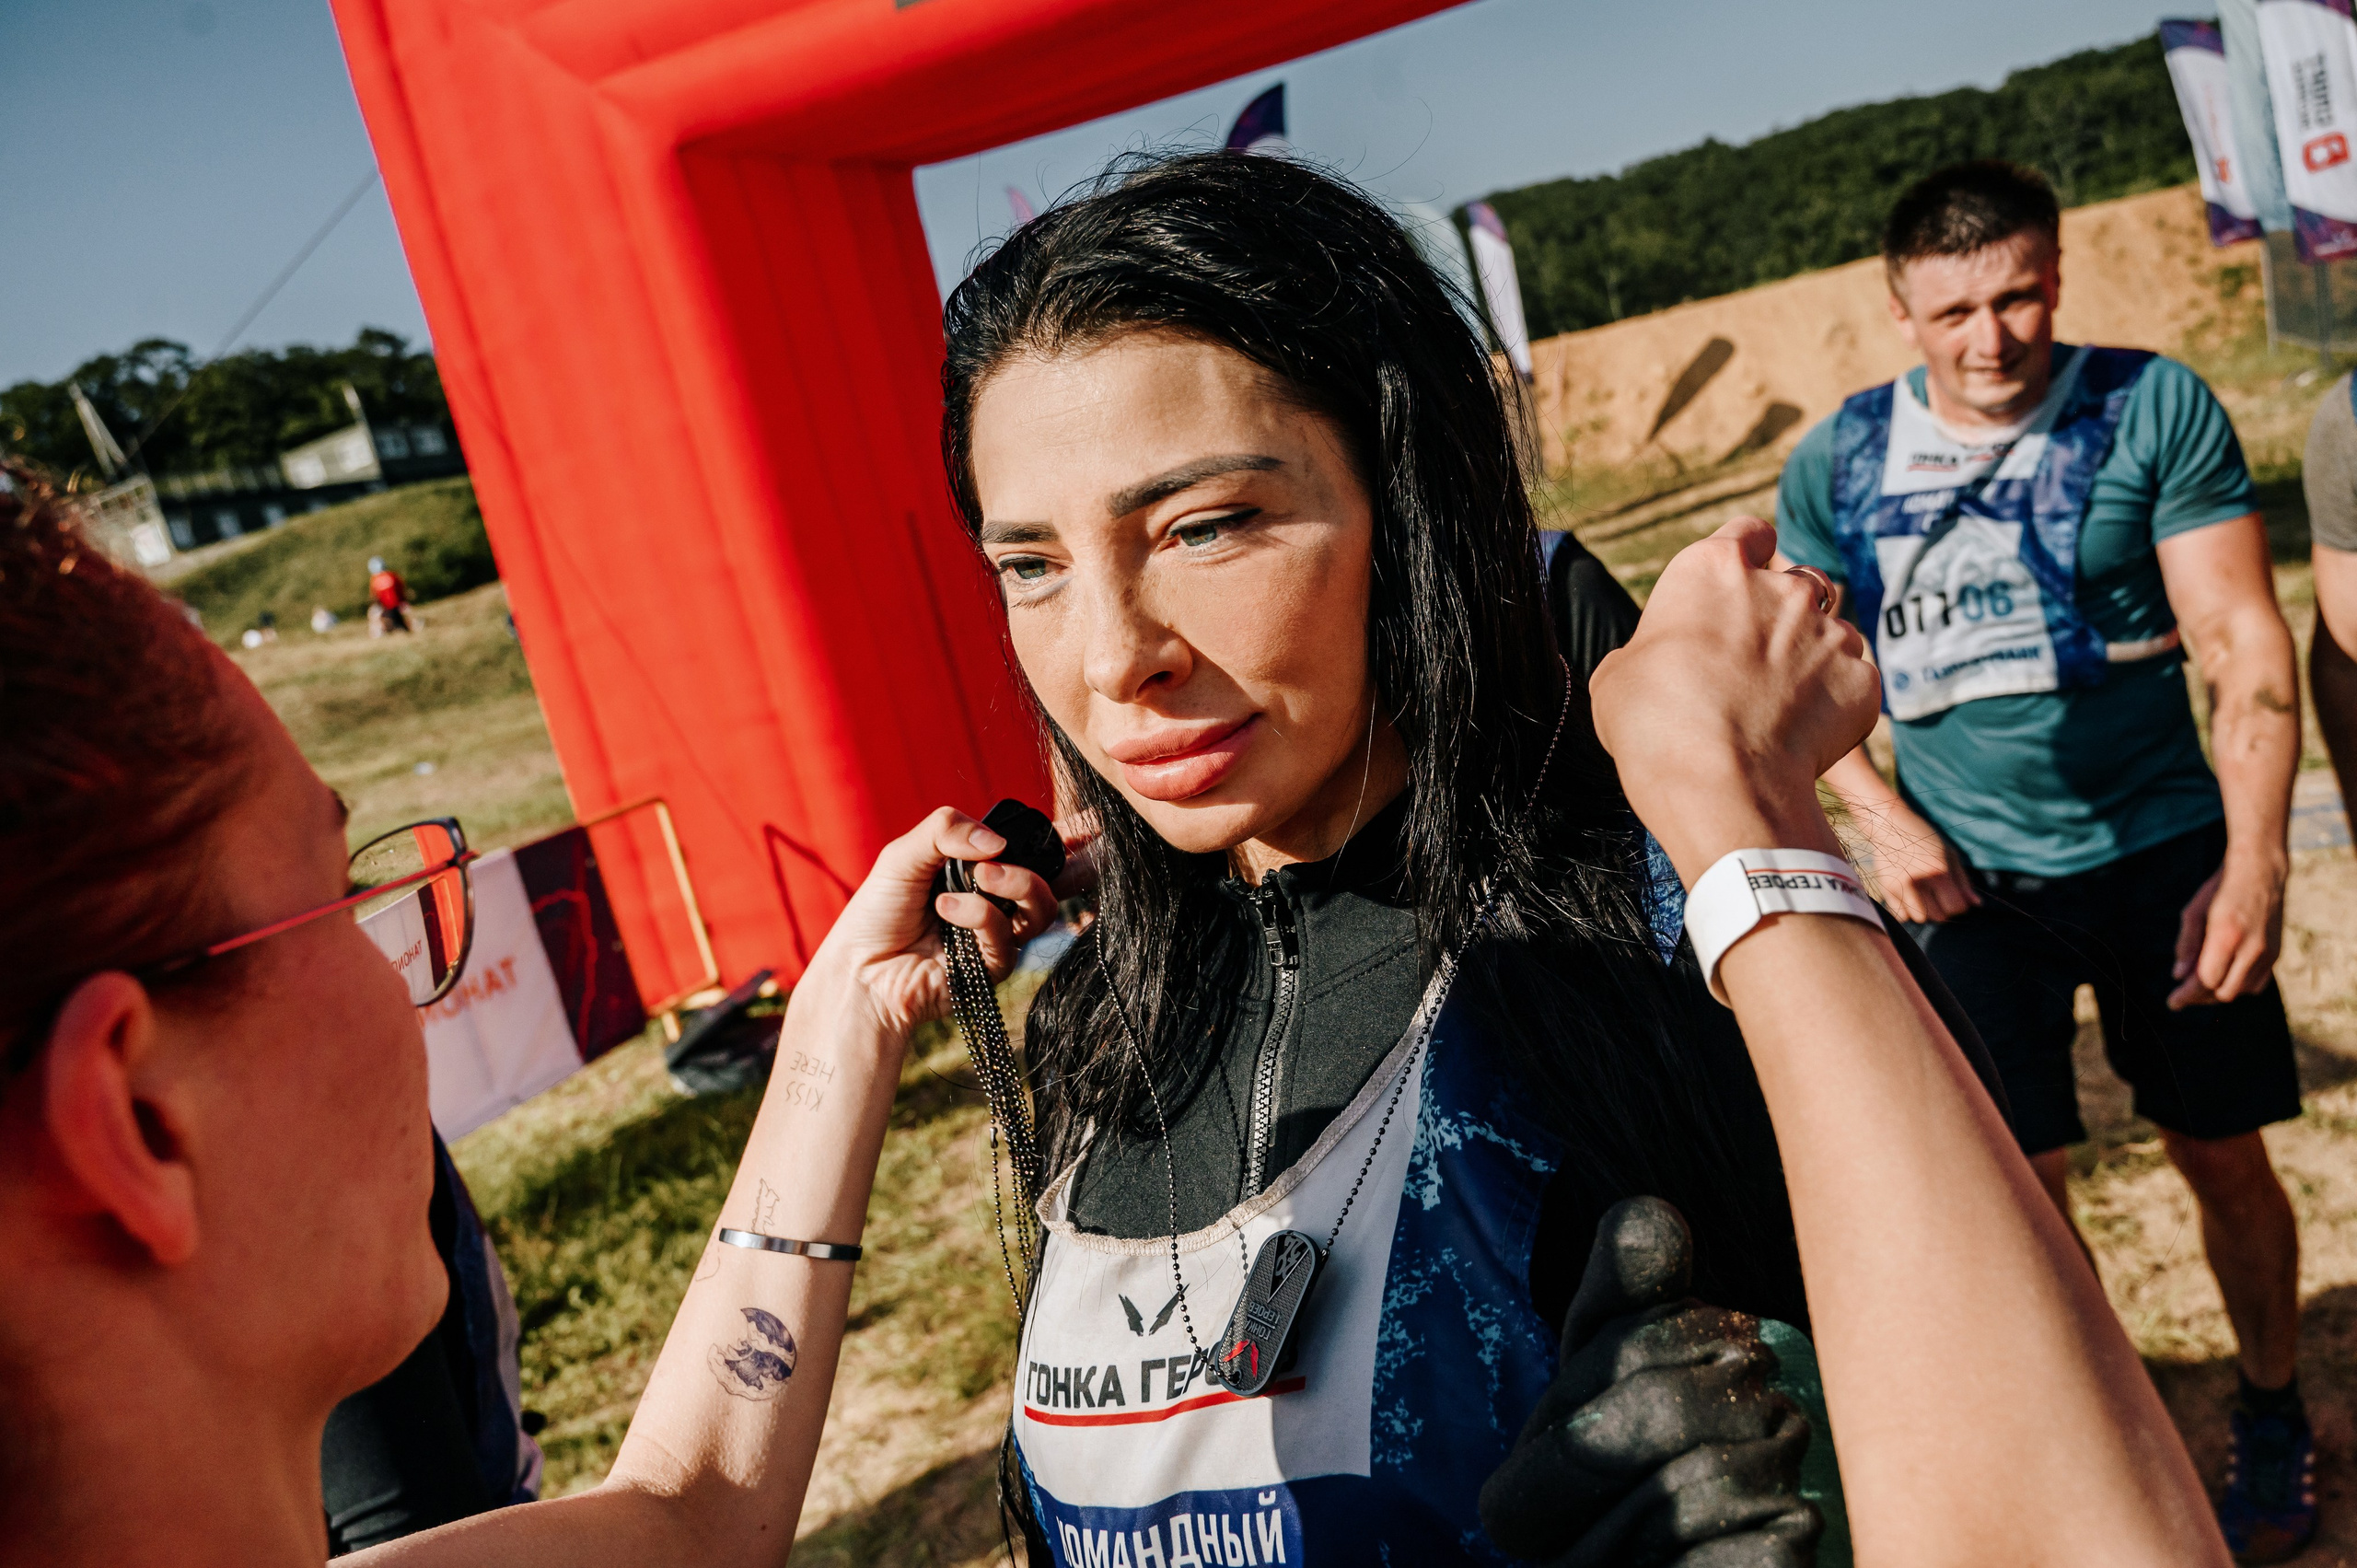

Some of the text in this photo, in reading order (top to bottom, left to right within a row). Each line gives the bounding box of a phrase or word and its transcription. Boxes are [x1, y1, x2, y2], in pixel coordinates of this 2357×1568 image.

[1749, 875, 1822, 890] ГЕРОЕВ
[391, 939, 423, 972] ПИОНАТ
[789, 1051, 836, 1085] HERE
[784, 1080, 825, 1112] KISS
[1026, 1361, 1126, 1410] ГОНКА
[1056, 1490, 1287, 1568] ОМАНДНЫЙ
